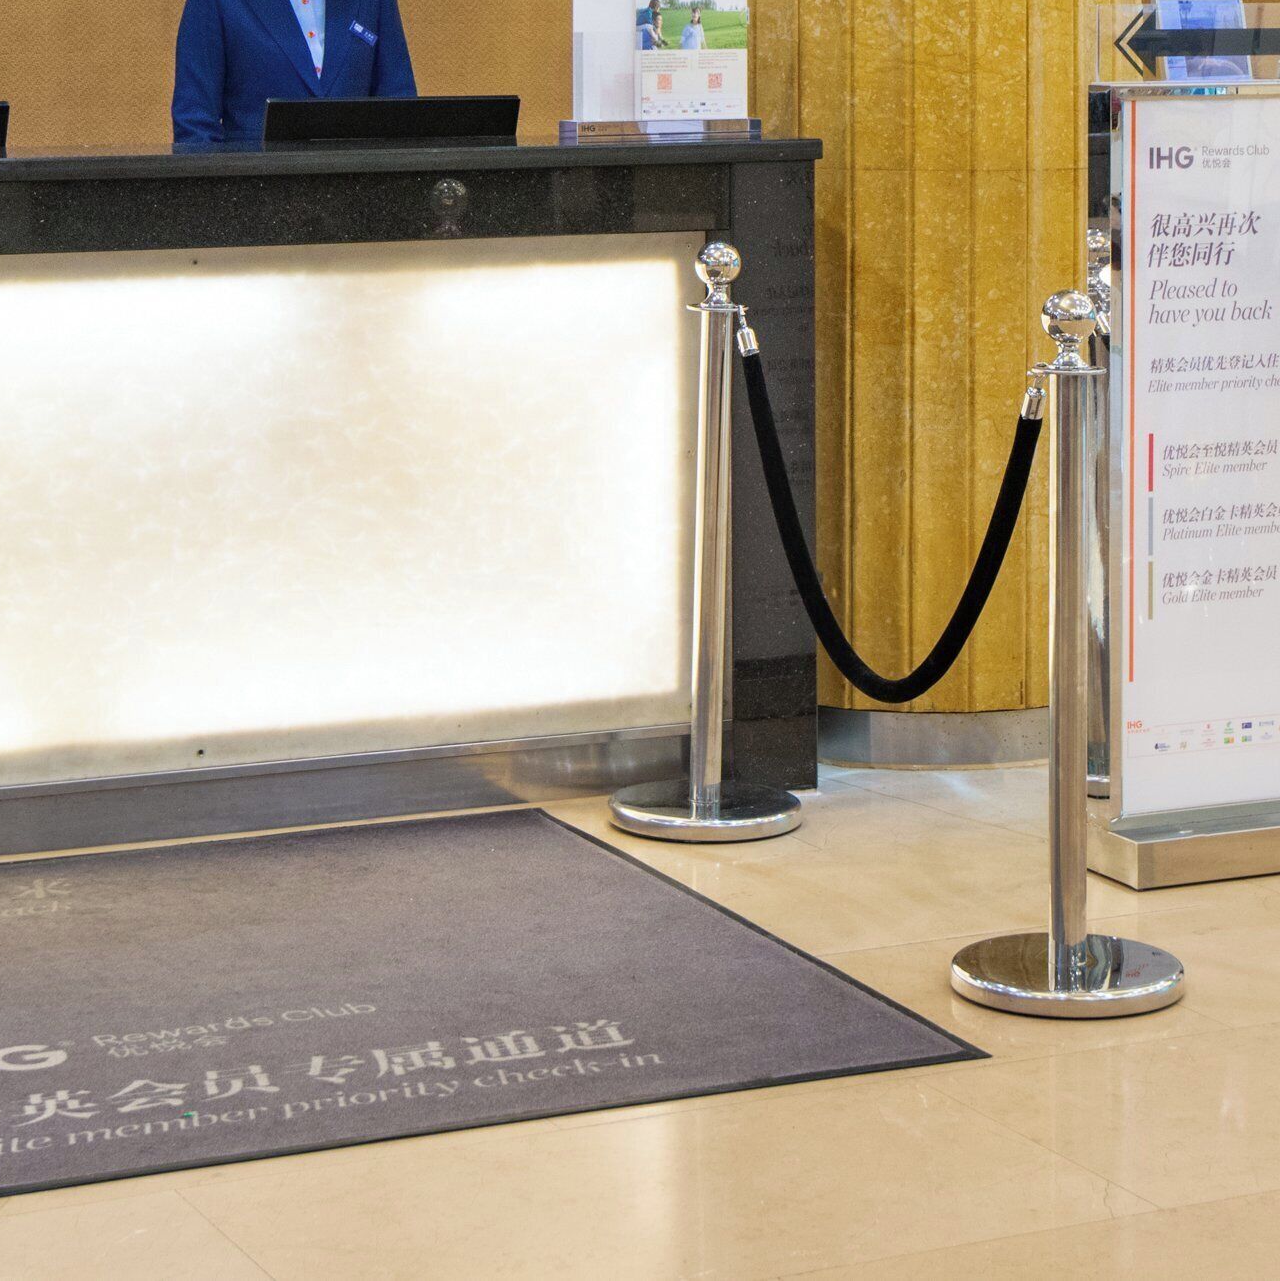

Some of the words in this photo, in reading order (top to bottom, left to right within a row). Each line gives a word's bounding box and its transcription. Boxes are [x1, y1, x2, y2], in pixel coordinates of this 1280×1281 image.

[581, 125, 596, 133] IHG
[1149, 145, 1194, 170] IHG
[1201, 145, 1245, 157] Rewards
[1246, 144, 1270, 156] Club
[1201, 158, 1231, 169] 优悦会
[1150, 210, 1262, 239] 很高兴再次
[1148, 241, 1236, 269] 伴您同行
[1149, 277, 1218, 301] Pleased
[1221, 279, 1238, 298] to
[1148, 303, 1191, 325] have
[1192, 306, 1226, 328] you
[1231, 299, 1273, 321] back
[1150, 352, 1280, 374] 精英会员优先登记入住
[1147, 379, 1173, 394] Elite
[1174, 377, 1220, 392] member
[1220, 375, 1263, 393] priority
[1162, 439, 1279, 461] 优悦会至悦精英会员
[1162, 463, 1192, 479] Spire
[1194, 461, 1221, 476] Elite
[1222, 459, 1268, 473] member
[1162, 526, 1213, 542] Platinum
[1216, 524, 1242, 538] Elite
[1162, 565, 1278, 589] 优悦会金卡精英会员
[1162, 590, 1188, 606] Gold
[1191, 588, 1217, 603] Elite
[1219, 585, 1264, 601] member
[1127, 720, 1143, 730] IHG
[91, 1016, 276, 1048] Rewards
[281, 1002, 378, 1022] Club
[107, 1034, 230, 1059] 优悦会
[66, 1105, 269, 1148] member
[284, 1076, 460, 1120] priority
[472, 1052, 666, 1088] check-in
